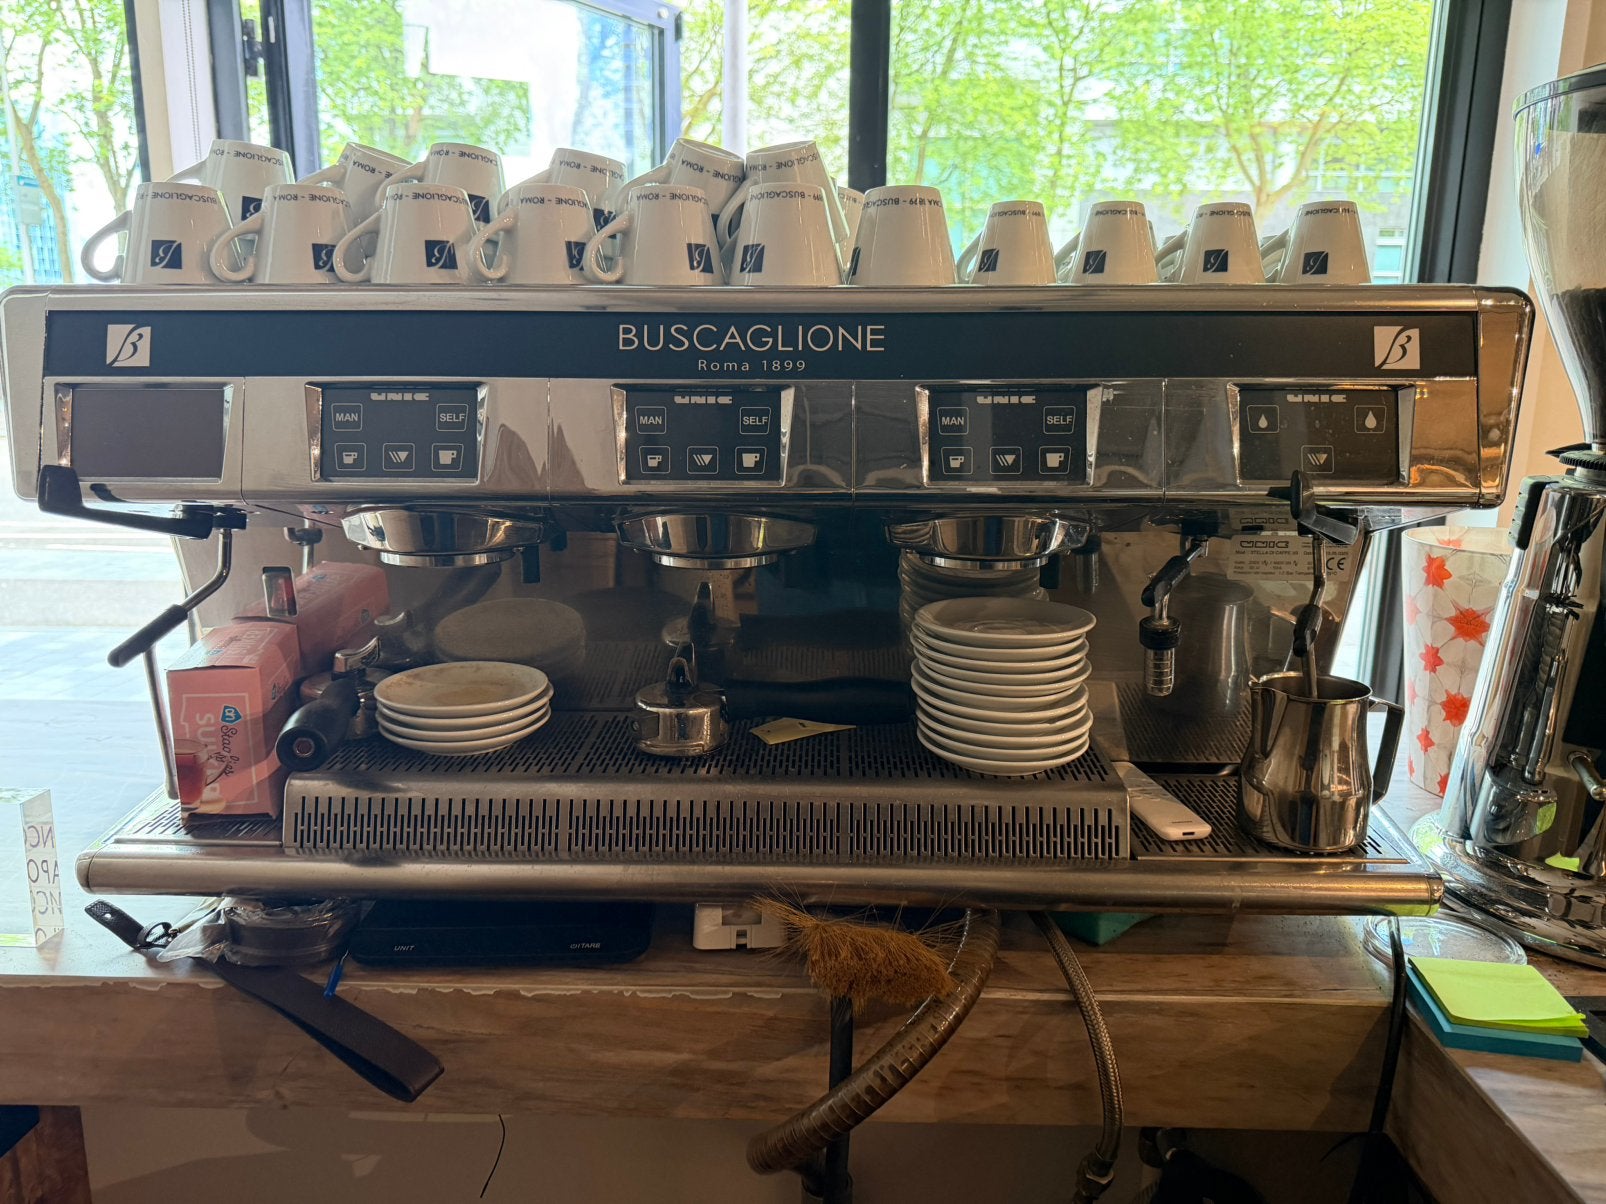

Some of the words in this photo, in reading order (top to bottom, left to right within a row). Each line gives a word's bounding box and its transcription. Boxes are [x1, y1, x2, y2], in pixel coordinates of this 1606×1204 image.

[352, 160, 376, 175] ROMA
[559, 159, 581, 170] ROMA
[681, 159, 705, 174] ROMA
[749, 163, 767, 172] ROMA
[150, 191, 217, 205] BUSCAGLIONE
[272, 193, 298, 202] ROMA
[520, 196, 545, 205] ROMA
[636, 193, 660, 201] ROMA
[618, 324, 885, 351] BUSCAGLIONE
[698, 359, 749, 372] Roma
[761, 359, 806, 372] 1899
[370, 392, 430, 401] UNIC
[674, 395, 733, 404] UNIC
[976, 395, 1036, 404] UNIC
[1286, 394, 1347, 403] UNIC
[335, 412, 358, 422] MAN
[439, 413, 465, 422] SELF
[639, 416, 662, 425] MAN
[742, 416, 769, 425] SELF
[941, 416, 965, 425] MAN
[1046, 415, 1073, 425] SELF
[1326, 557, 1346, 571] CE
